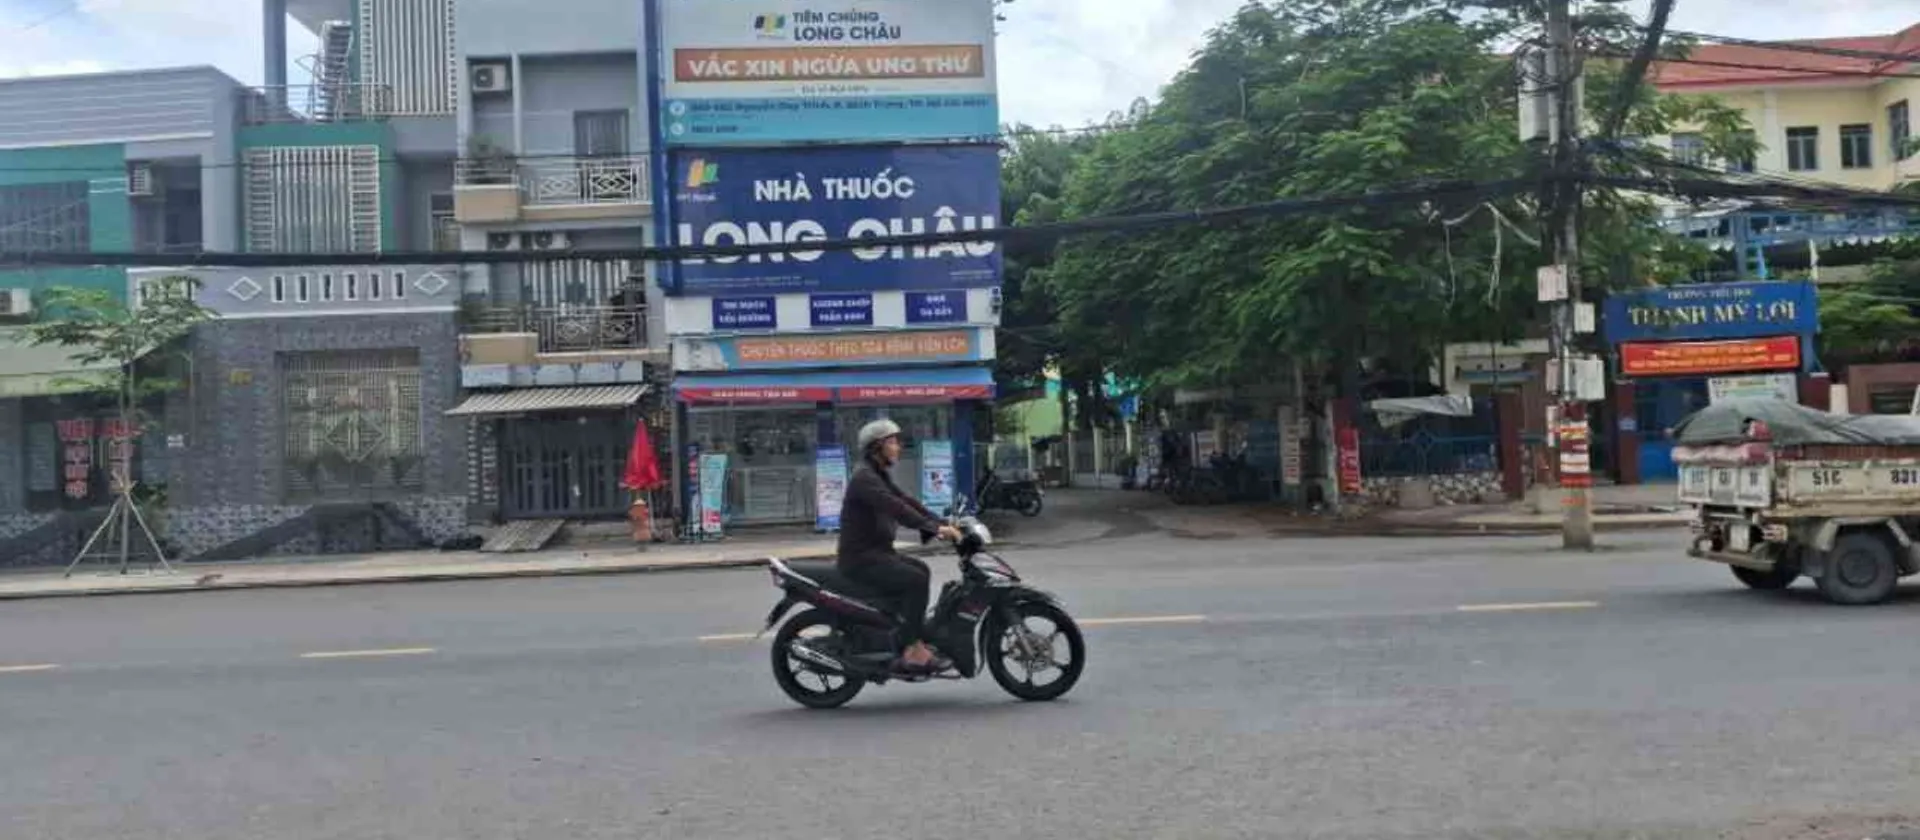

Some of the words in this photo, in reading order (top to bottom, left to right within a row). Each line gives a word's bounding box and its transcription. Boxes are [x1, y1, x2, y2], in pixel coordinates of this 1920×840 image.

[793, 26, 844, 41] LONG
[850, 22, 901, 41] CHÂU
[744, 58, 786, 77] XIN
[792, 53, 861, 76] NGỪA
[866, 55, 917, 75] UNG
[923, 53, 972, 73] THƯ
[754, 172, 812, 201] NHÀ
[822, 167, 916, 200] THUỐC
[677, 218, 827, 265] LONG
[848, 205, 996, 261] CHÂU
[1812, 469, 1841, 486] 51C
